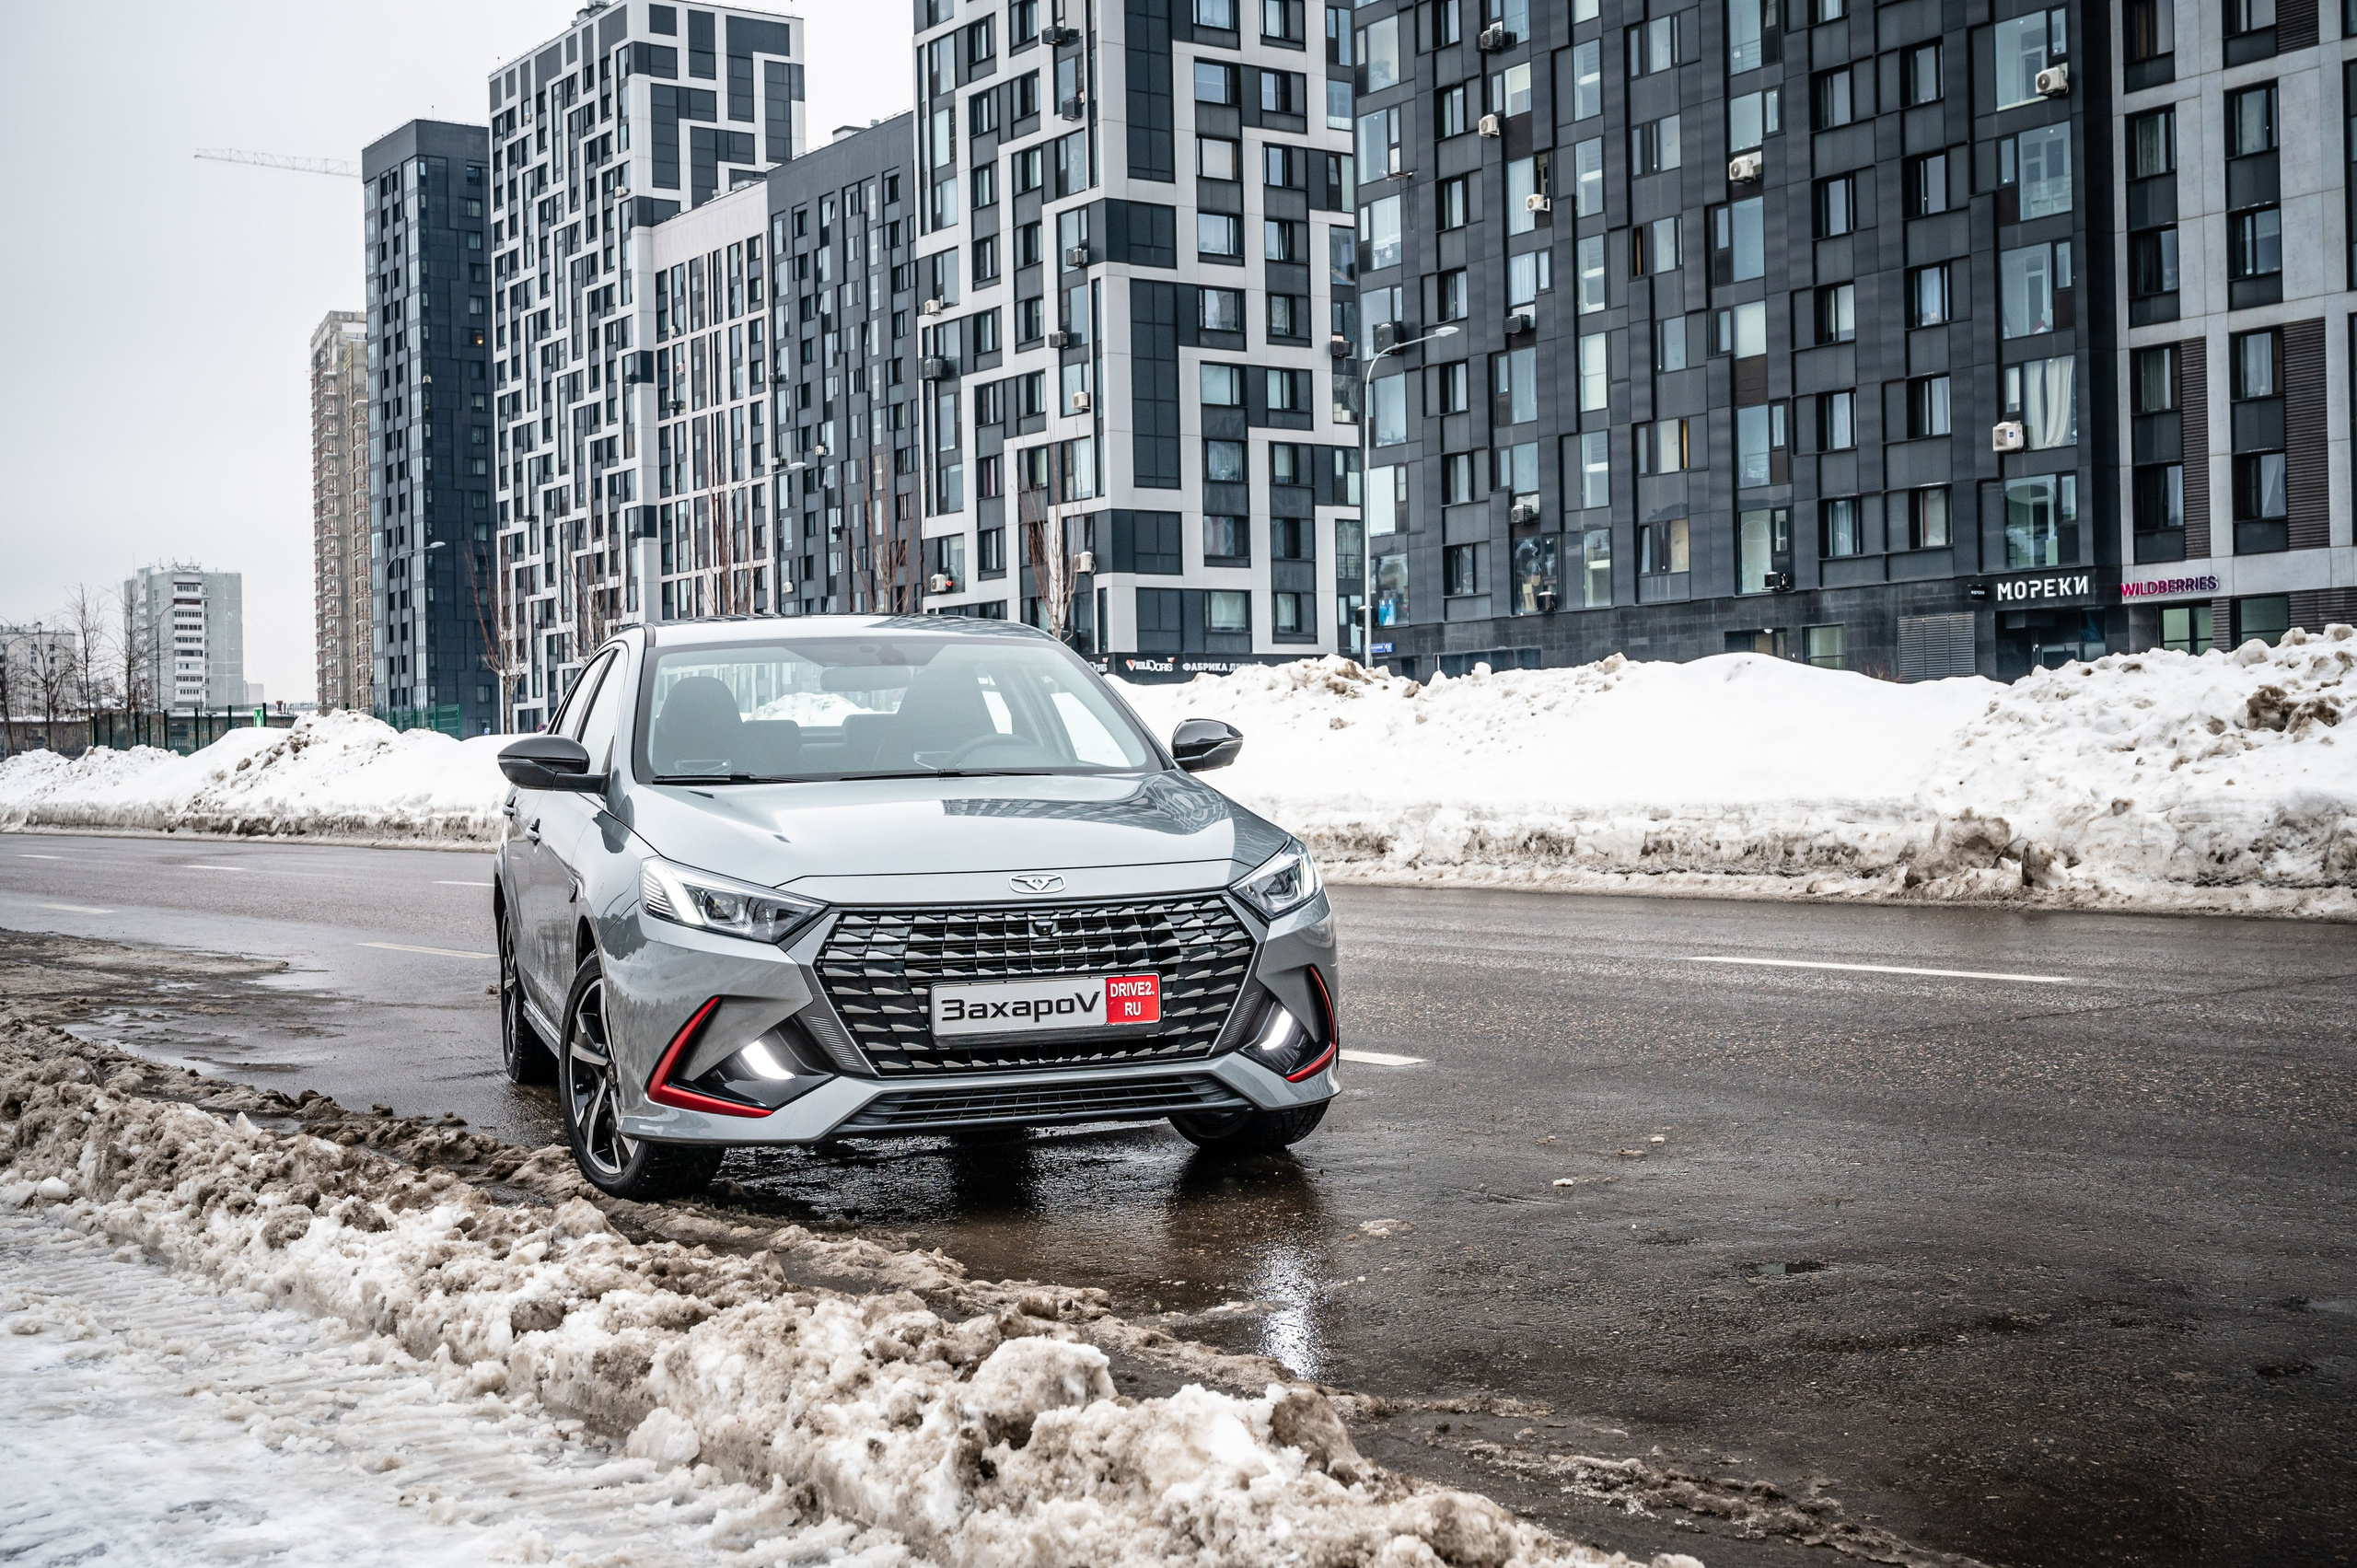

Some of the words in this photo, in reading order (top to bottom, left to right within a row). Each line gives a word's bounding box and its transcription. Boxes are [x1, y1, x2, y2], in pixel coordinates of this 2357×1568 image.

[1997, 575, 2089, 601] МОРЕКИ
[2120, 575, 2219, 598] WILDBERRIES
[1182, 662, 1227, 672] ФАБРИКА
[1124, 1001, 1142, 1016] RU
